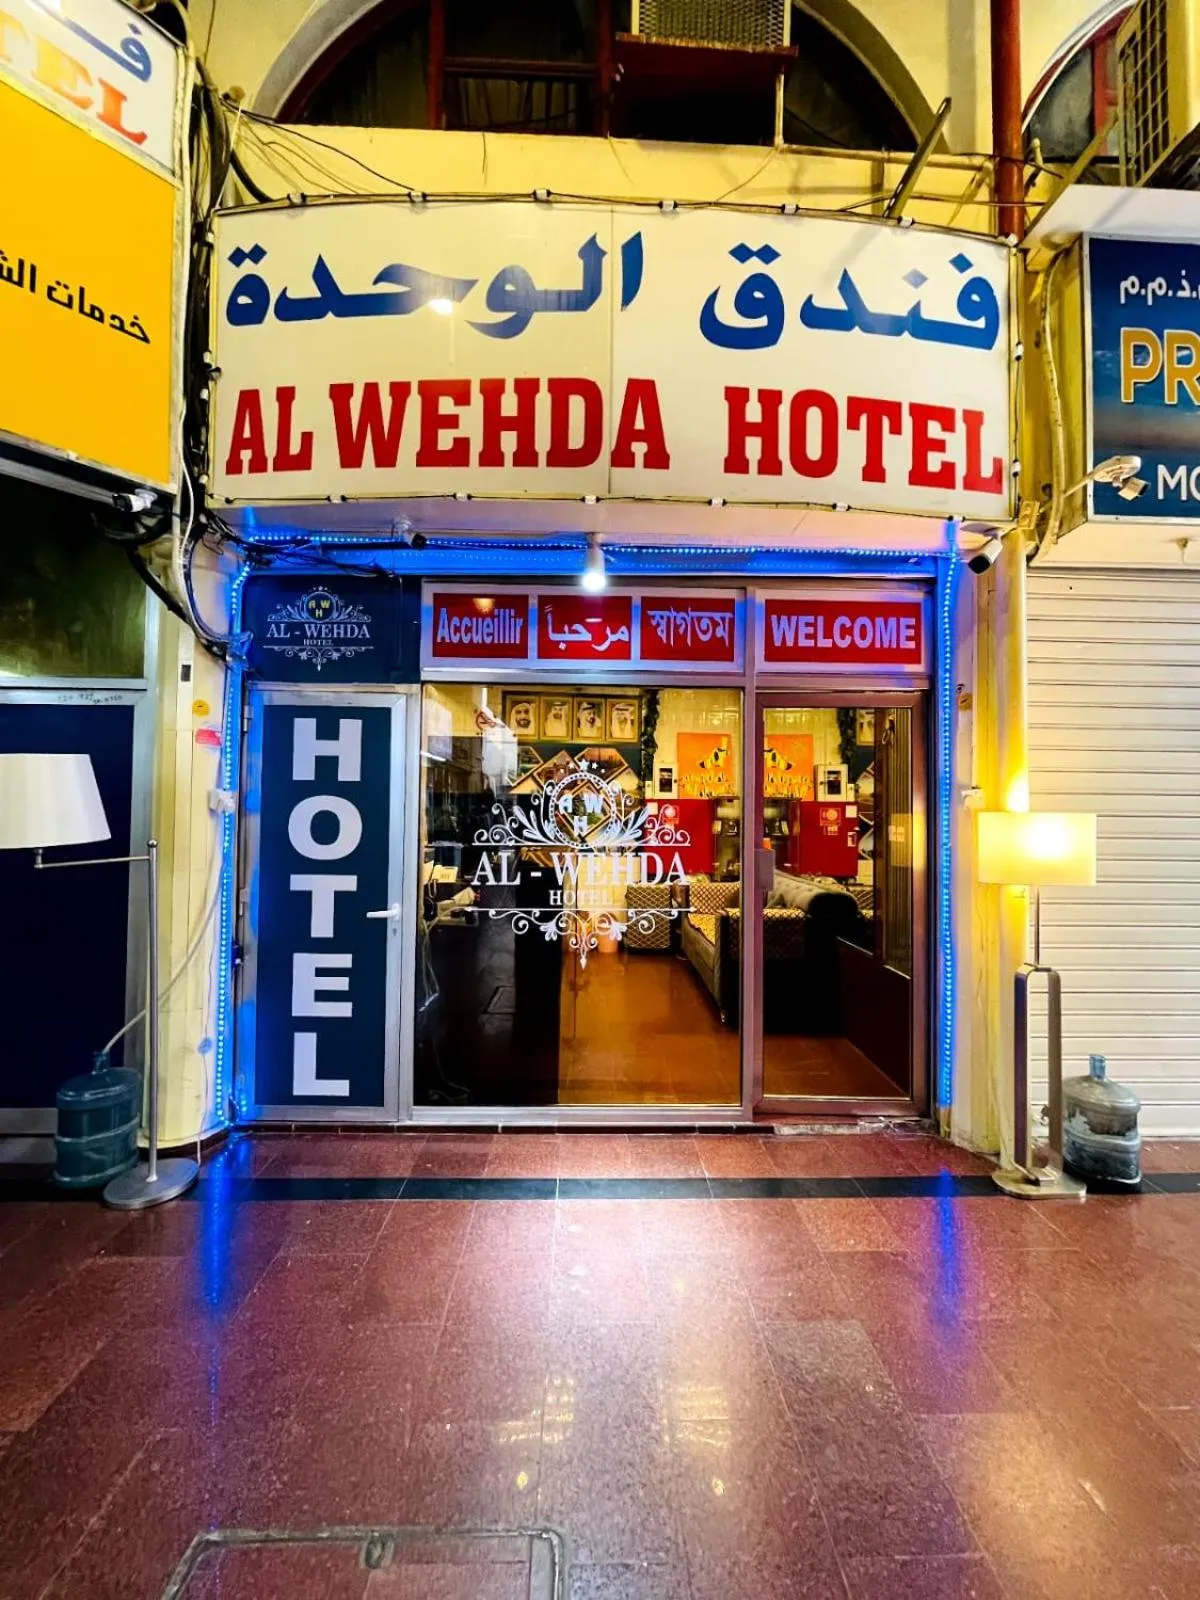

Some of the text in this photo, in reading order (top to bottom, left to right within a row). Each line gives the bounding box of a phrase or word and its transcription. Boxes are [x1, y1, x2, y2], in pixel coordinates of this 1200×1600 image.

[46, 279, 151, 345] خدمات
[226, 233, 1001, 352] فندق الوحدة
[1119, 326, 1200, 406] PR
[227, 377, 1004, 495] AL WEHDA HOTEL
[266, 623, 291, 638] AL
[304, 623, 371, 638] WEHDA
[436, 607, 524, 645] Accueillir
[646, 605, 735, 648] স্বাগতম
[770, 614, 916, 649] WELCOME
[471, 851, 521, 886] AL
[550, 851, 692, 886] WEHDA
[288, 717, 363, 1097] HOTEL
[548, 889, 614, 906] HOTEL
